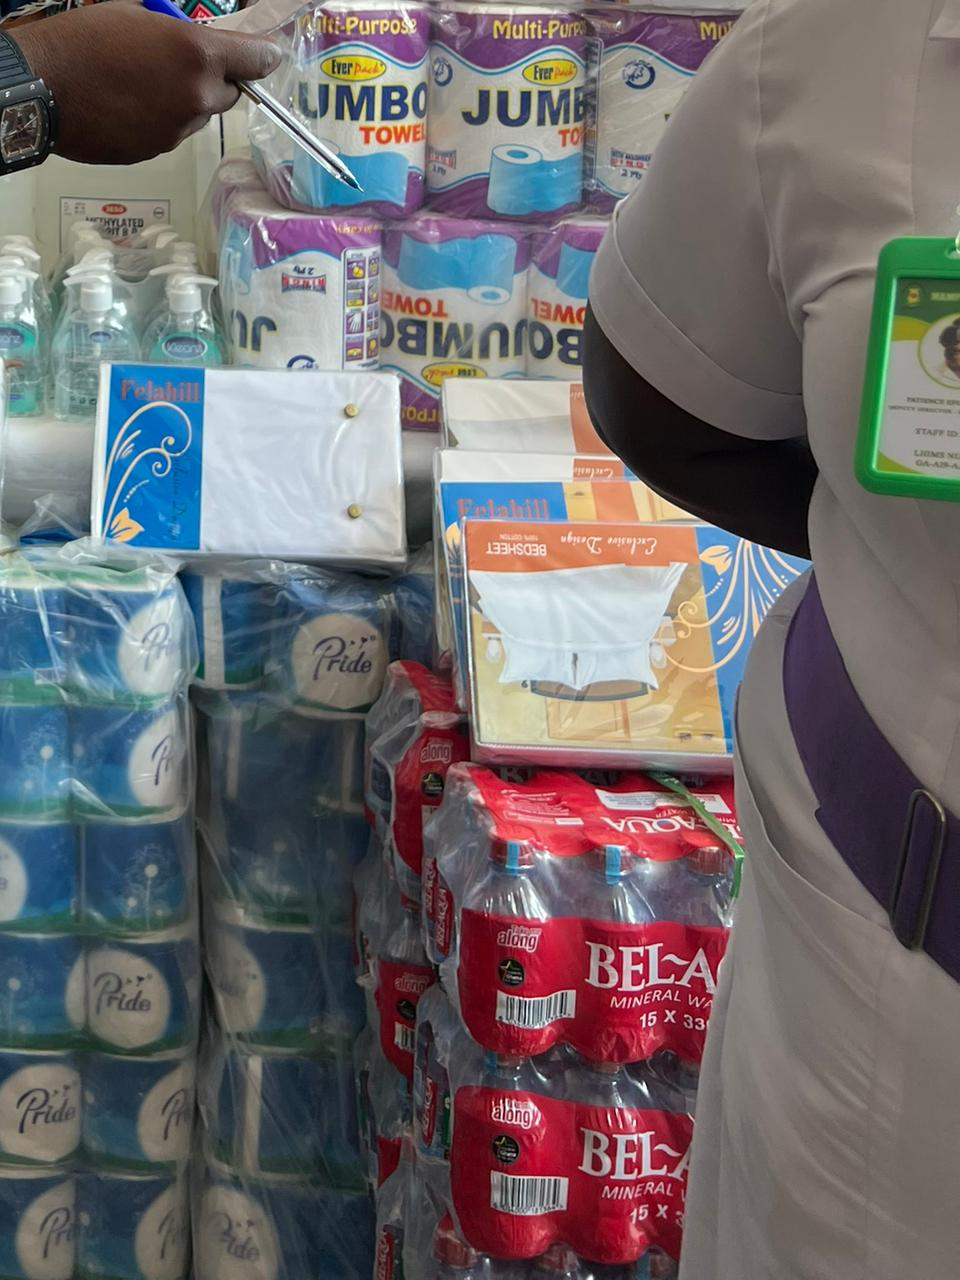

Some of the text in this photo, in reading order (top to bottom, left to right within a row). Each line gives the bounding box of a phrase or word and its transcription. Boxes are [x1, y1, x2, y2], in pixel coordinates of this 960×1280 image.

[493, 19, 587, 39] Multi-Purpo
[331, 59, 353, 76] Ever
[533, 64, 554, 81] Ever
[298, 81, 428, 122] UMBO
[461, 87, 586, 127] JUMB
[382, 289, 449, 319] TOWE
[530, 297, 589, 326] OWEL
[121, 378, 200, 403] Felahill
[485, 541, 548, 557] BEDSHEET
[560, 531, 658, 556] Exclusive Design
[312, 635, 373, 681] Pride
[420, 743, 454, 765] along
[497, 928, 540, 953] along
[585, 941, 717, 995] BEL-A
[93, 970, 151, 1016] Pride
[610, 989, 681, 1010] MINERAL
[640, 1010, 657, 1030] 15
[16, 1087, 77, 1134] Pride
[492, 1101, 533, 1130] along
[602, 1181, 674, 1201] MINERAL
[630, 1203, 649, 1224] 15
